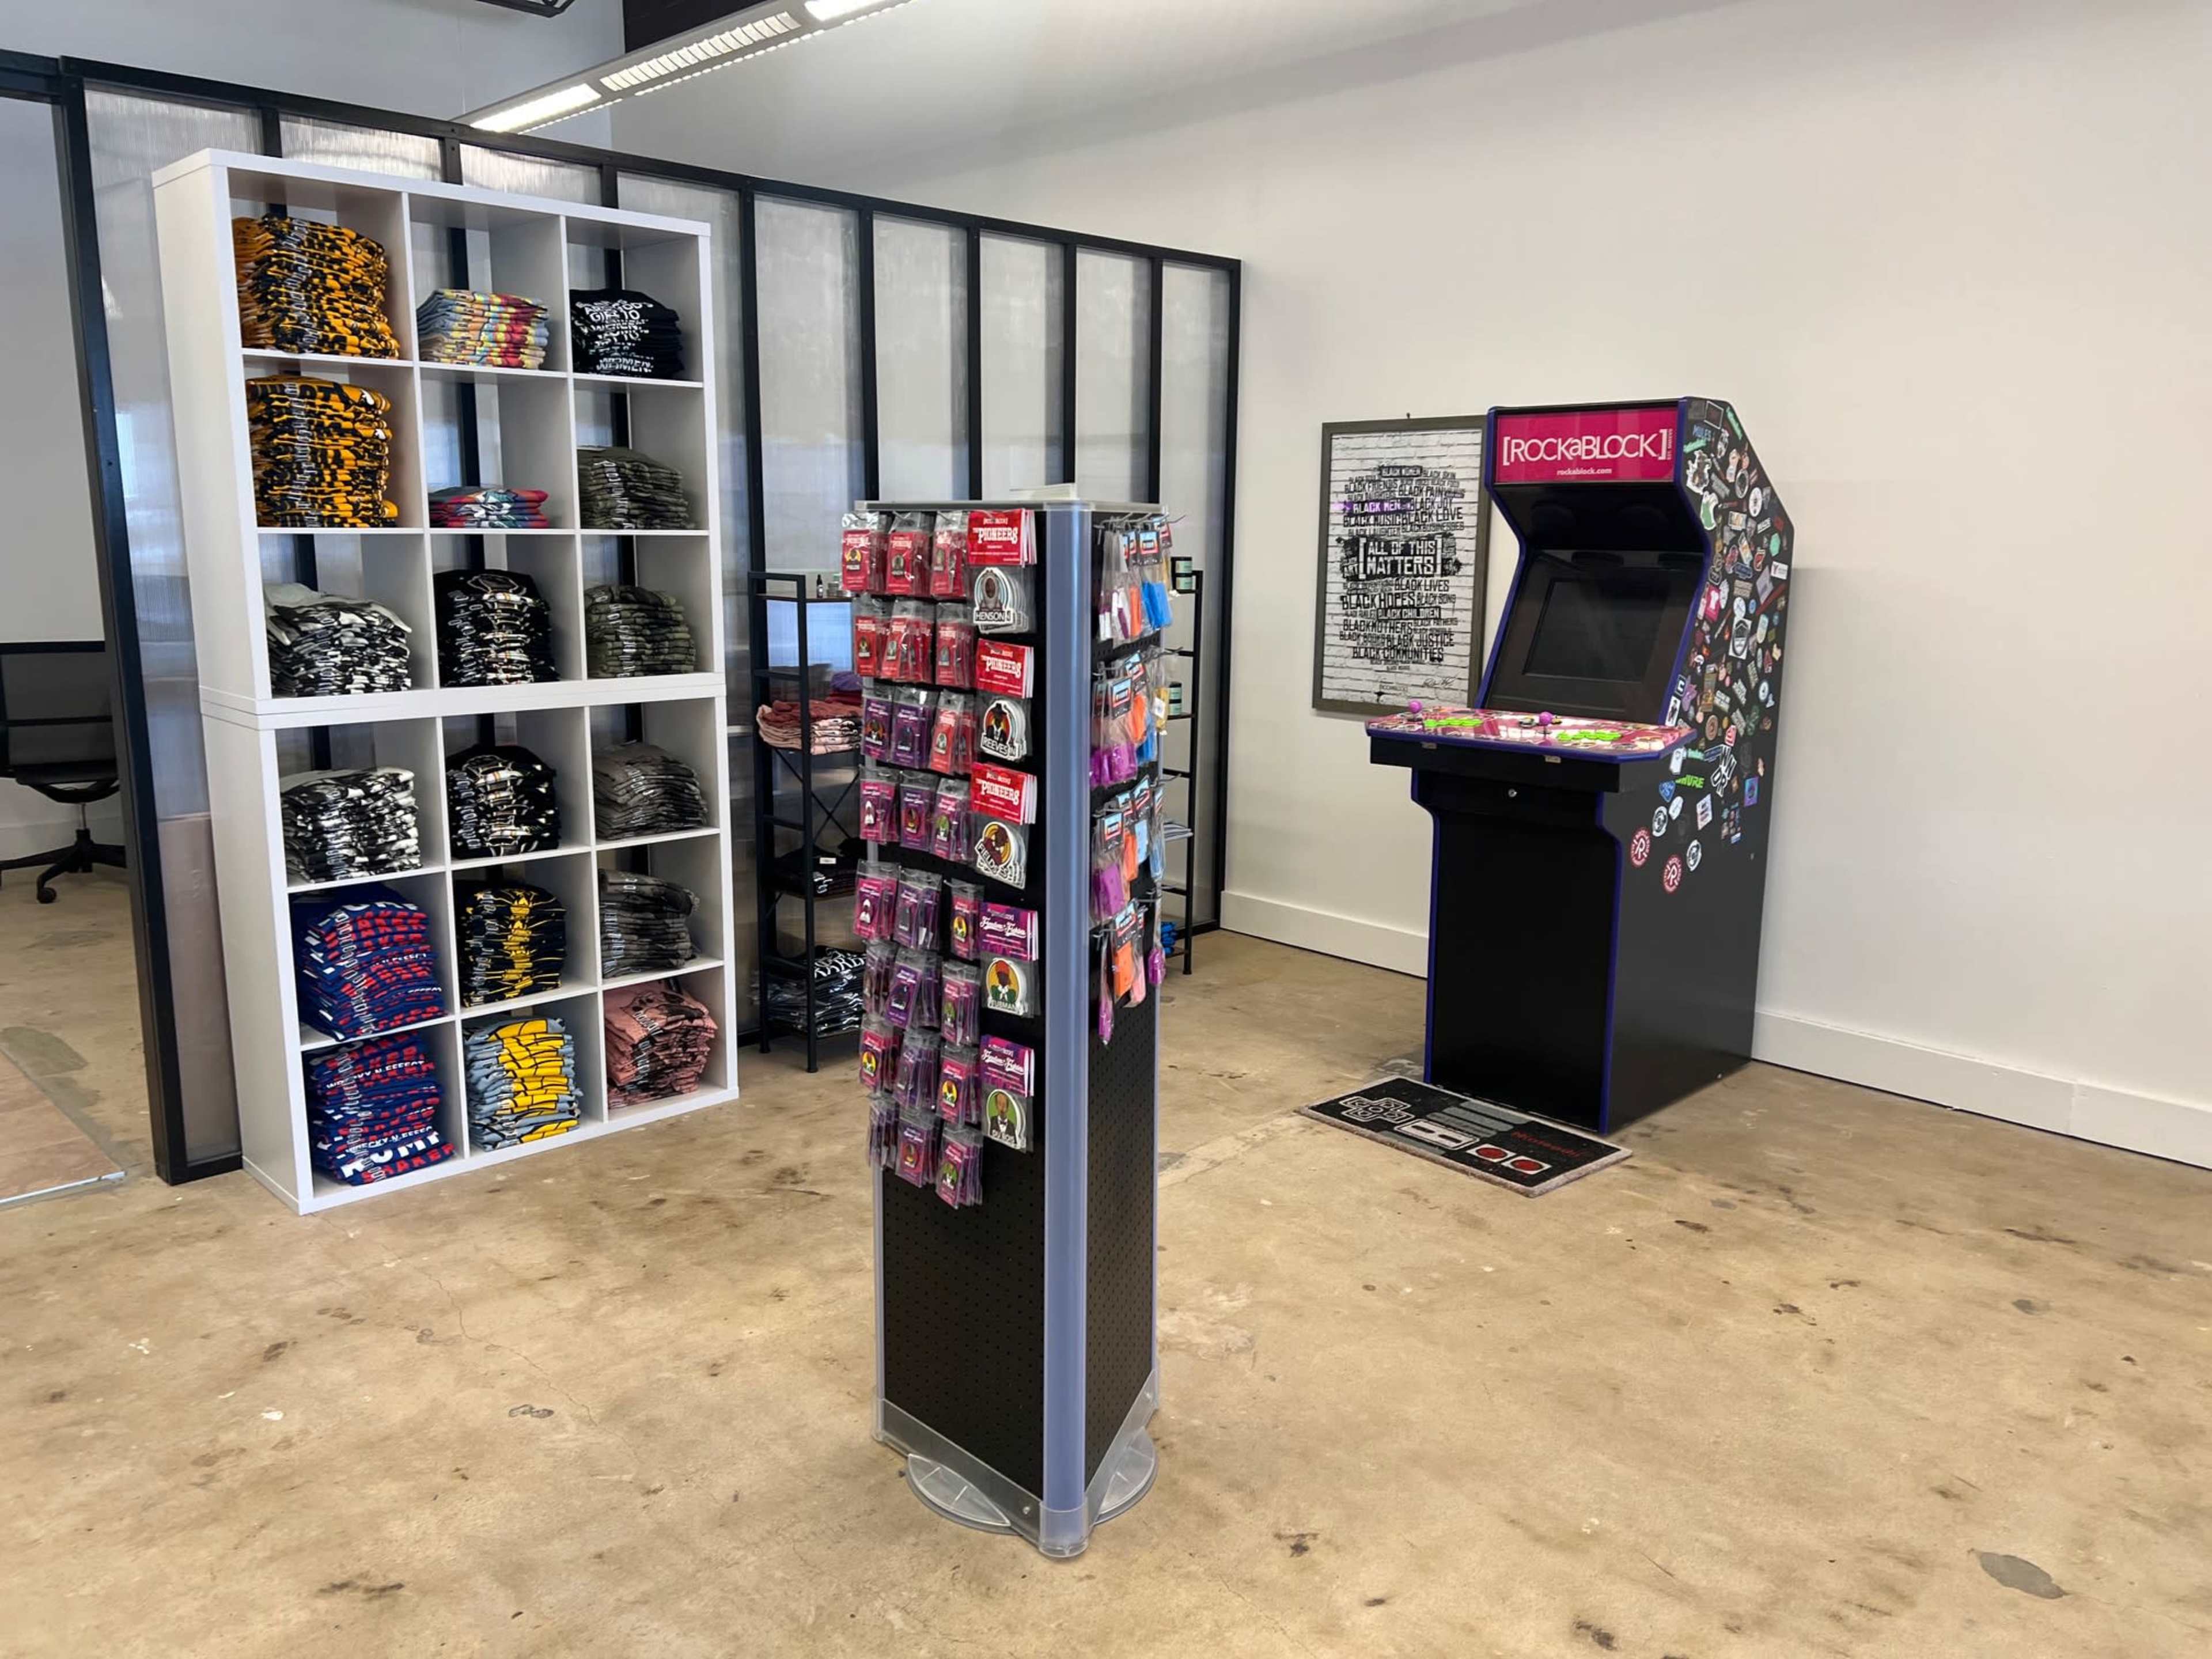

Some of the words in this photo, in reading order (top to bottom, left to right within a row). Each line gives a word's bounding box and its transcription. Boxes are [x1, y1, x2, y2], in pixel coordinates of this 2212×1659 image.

[1399, 485, 1425, 497] BLACK
[1354, 502, 1381, 513] BLACK
[1384, 501, 1401, 512] MEN
[1411, 497, 1435, 511] BLACK
[1344, 515, 1373, 527] BLACK
[1374, 514, 1401, 527] MUSIC
[1402, 511, 1434, 525] BLACK
[1436, 507, 1463, 522] LOVE
[1368, 541, 1388, 555] ALL
[1391, 541, 1404, 555] OF
[1410, 540, 1435, 555] THIS
[1367, 556, 1434, 574] MATTERS
[1395, 579, 1422, 592] BLACK
[1424, 579, 1450, 592] LIVES
[1341, 594, 1377, 609] BLACK
[1379, 592, 1415, 608] HOPES
[975, 612, 1005, 621] HENSON
[1378, 608, 1402, 618] BLACK
[1343, 619, 1372, 632] BLACK
[1372, 620, 1412, 634] MOTHERS
[1387, 634, 1414, 647] BLACK
[1416, 634, 1455, 647] JUSTICE
[1353, 647, 1381, 659] BLACK
[1384, 647, 1444, 662] COMMUNITIES
